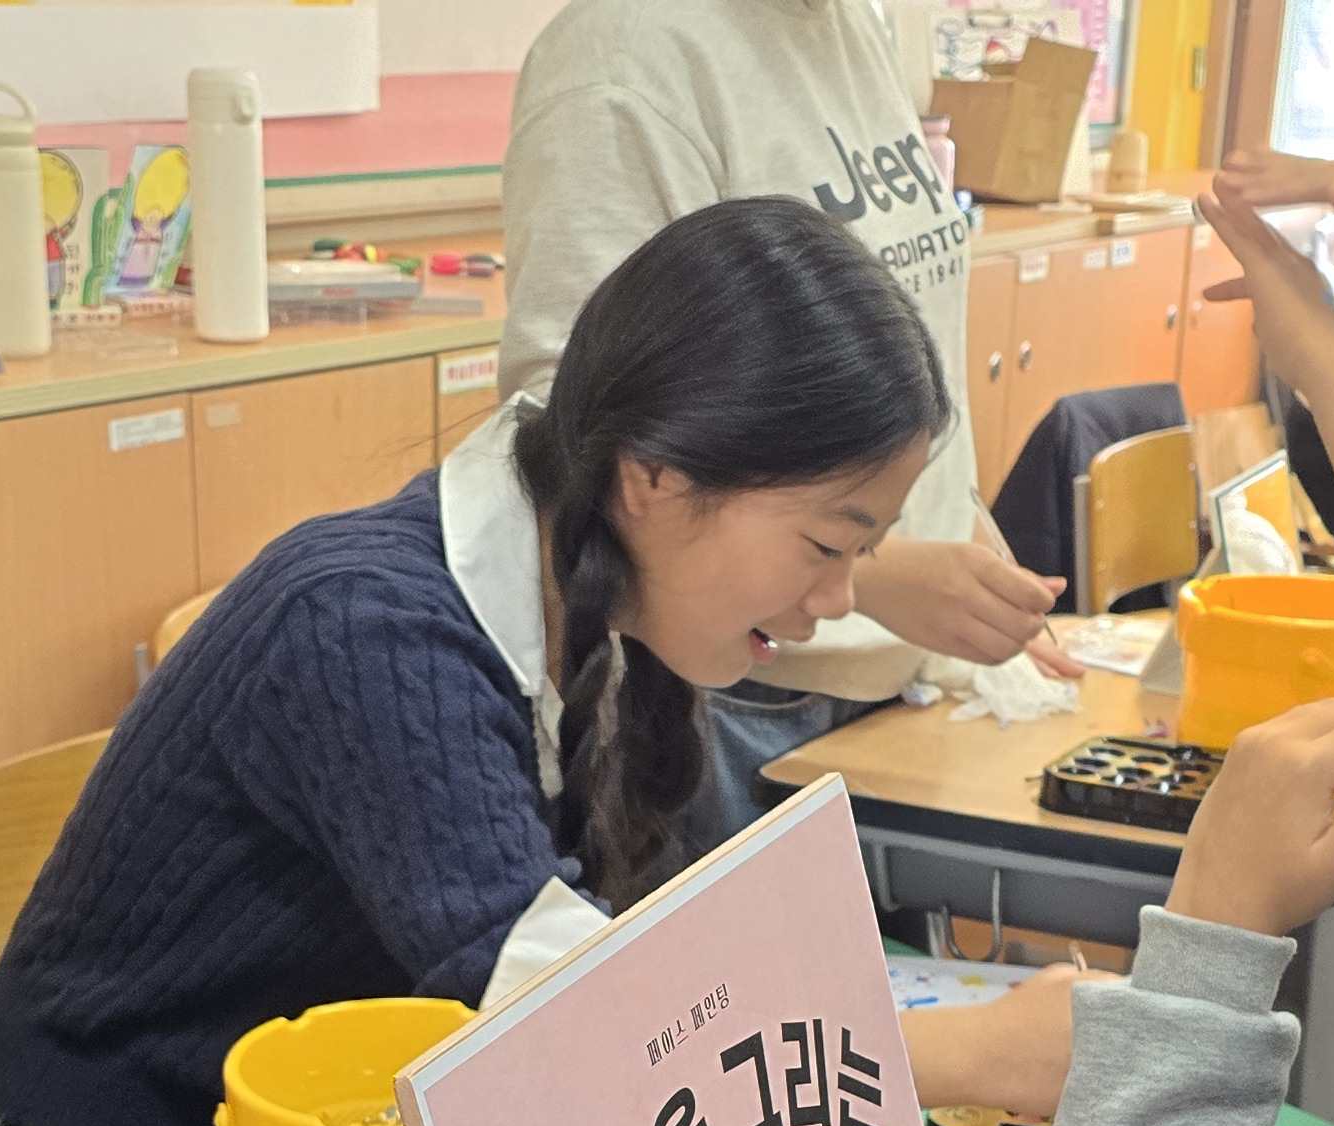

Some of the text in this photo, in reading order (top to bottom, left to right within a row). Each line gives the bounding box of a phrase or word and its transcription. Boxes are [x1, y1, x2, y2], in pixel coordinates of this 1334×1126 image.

[813, 126, 943, 223] Jeep
[880, 219, 966, 269] ADIATO
[647, 983, 730, 1067] 페이스 페인팅
